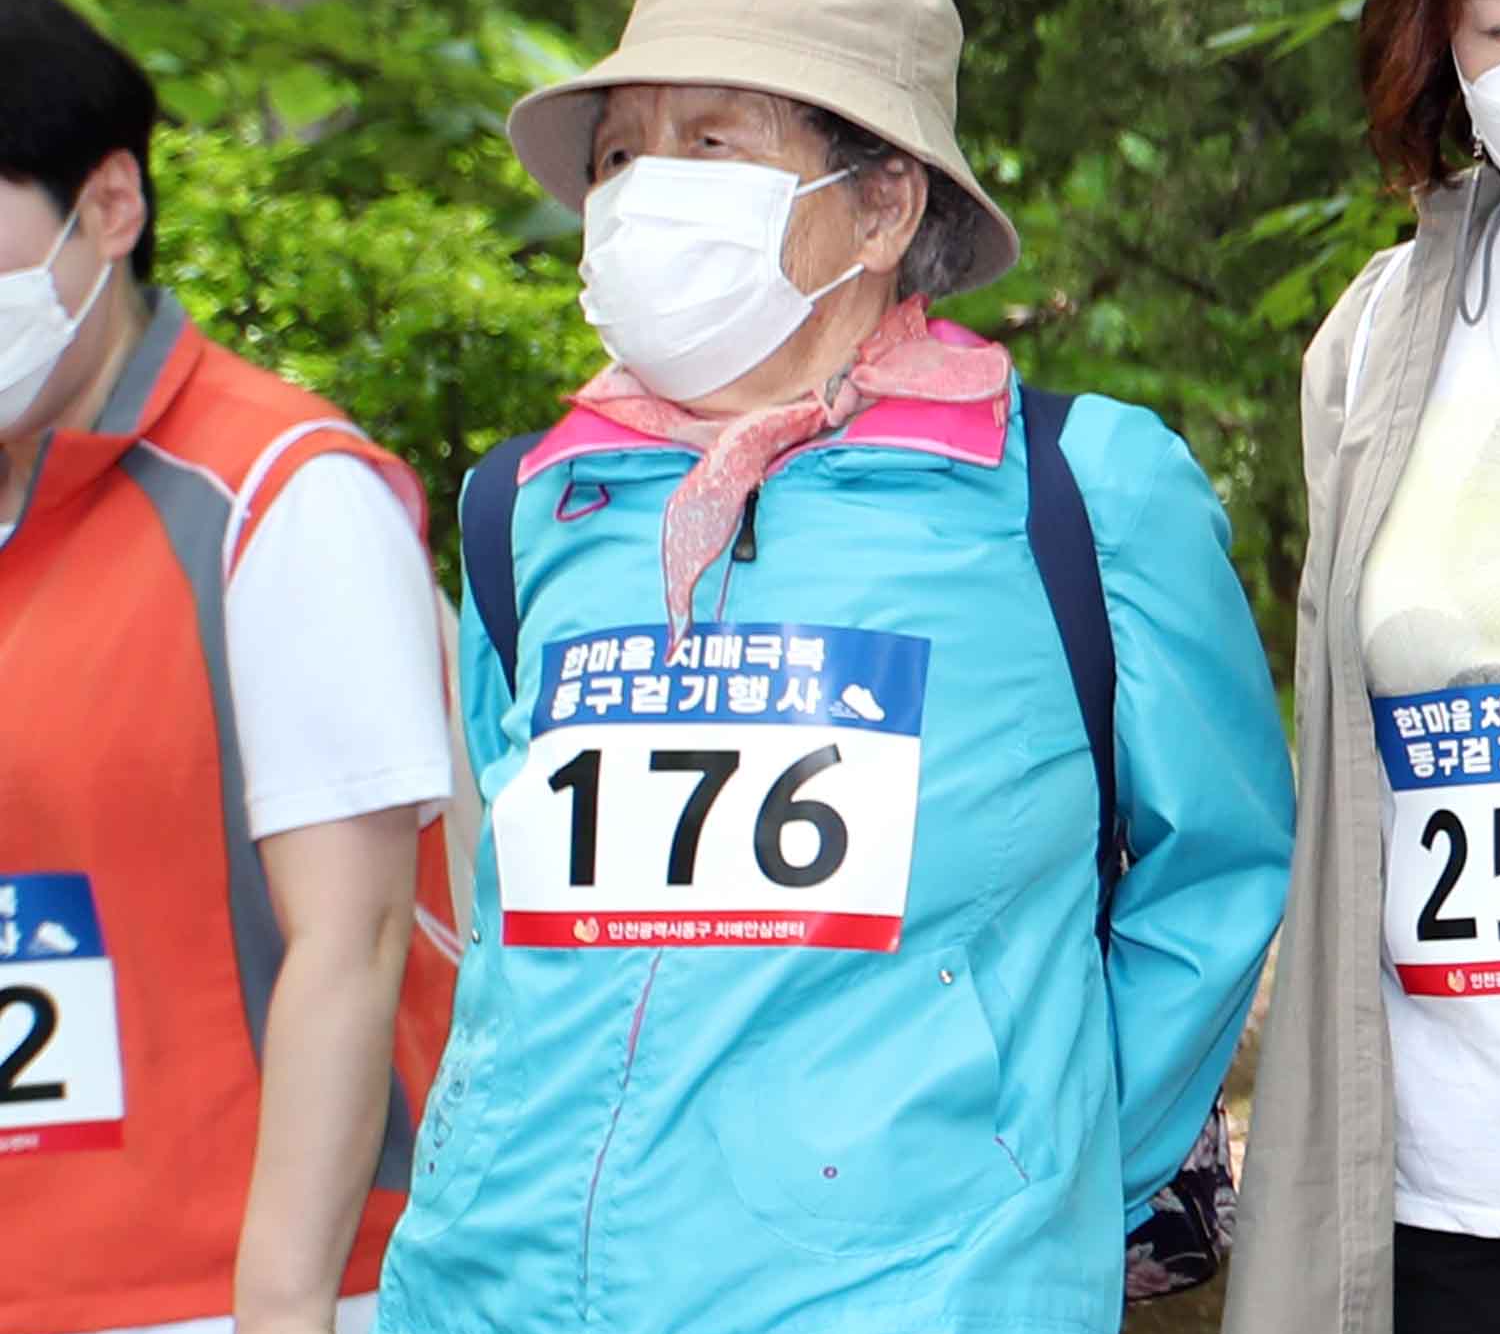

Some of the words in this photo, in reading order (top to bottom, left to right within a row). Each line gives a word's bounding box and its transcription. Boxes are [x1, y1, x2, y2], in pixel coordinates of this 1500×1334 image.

[560, 635, 655, 682] 한마음
[666, 634, 825, 672] 치매극복
[1392, 698, 1473, 739] 한마음
[548, 744, 848, 889] 176
